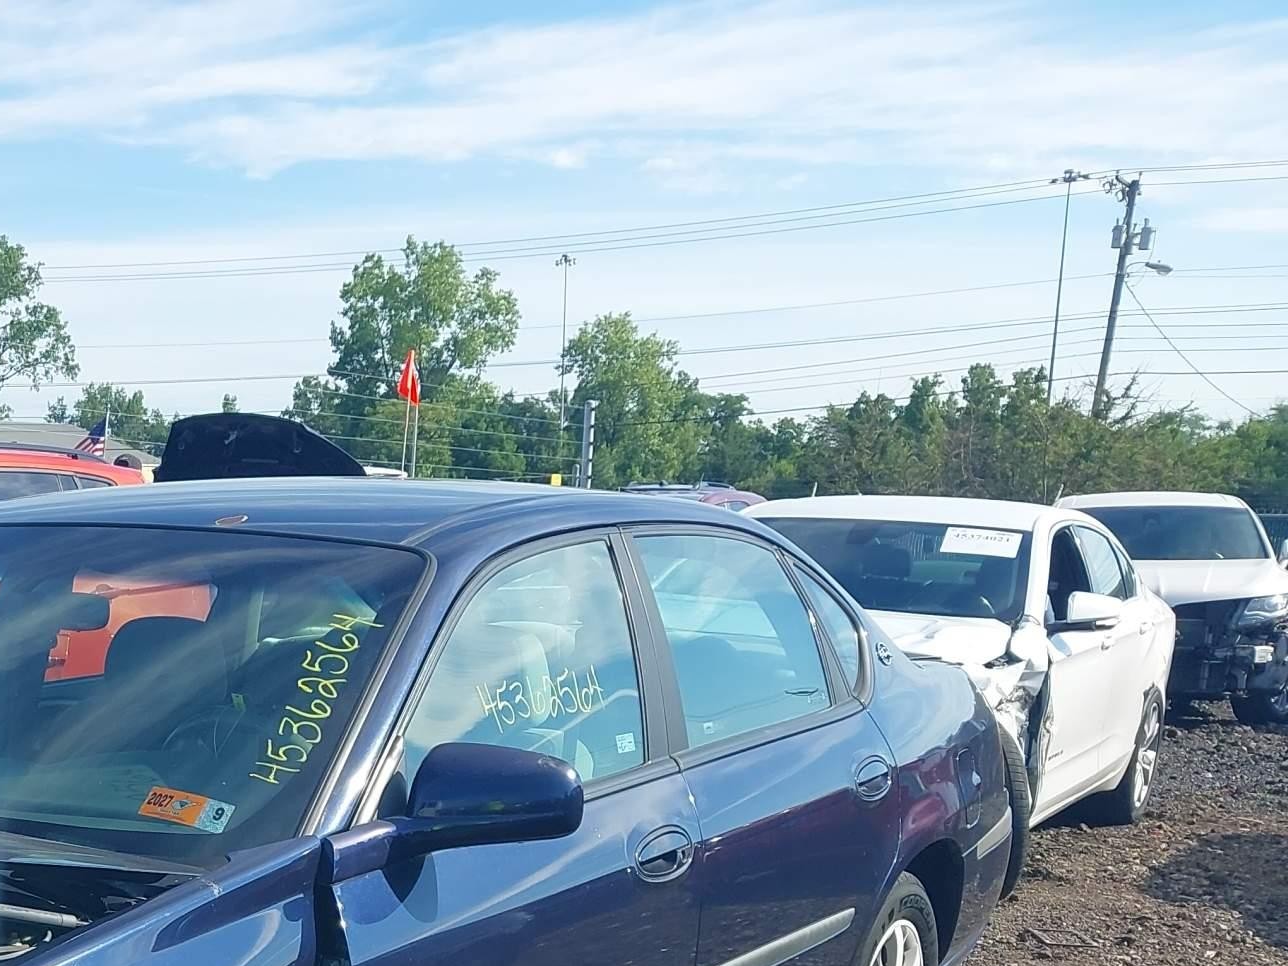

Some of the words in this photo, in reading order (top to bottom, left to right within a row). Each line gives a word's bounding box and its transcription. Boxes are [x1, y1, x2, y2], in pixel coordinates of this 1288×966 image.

[249, 614, 385, 785] 45362564
[476, 664, 606, 734] 45362564
[146, 791, 174, 808] 2027
[212, 807, 226, 821] 9
